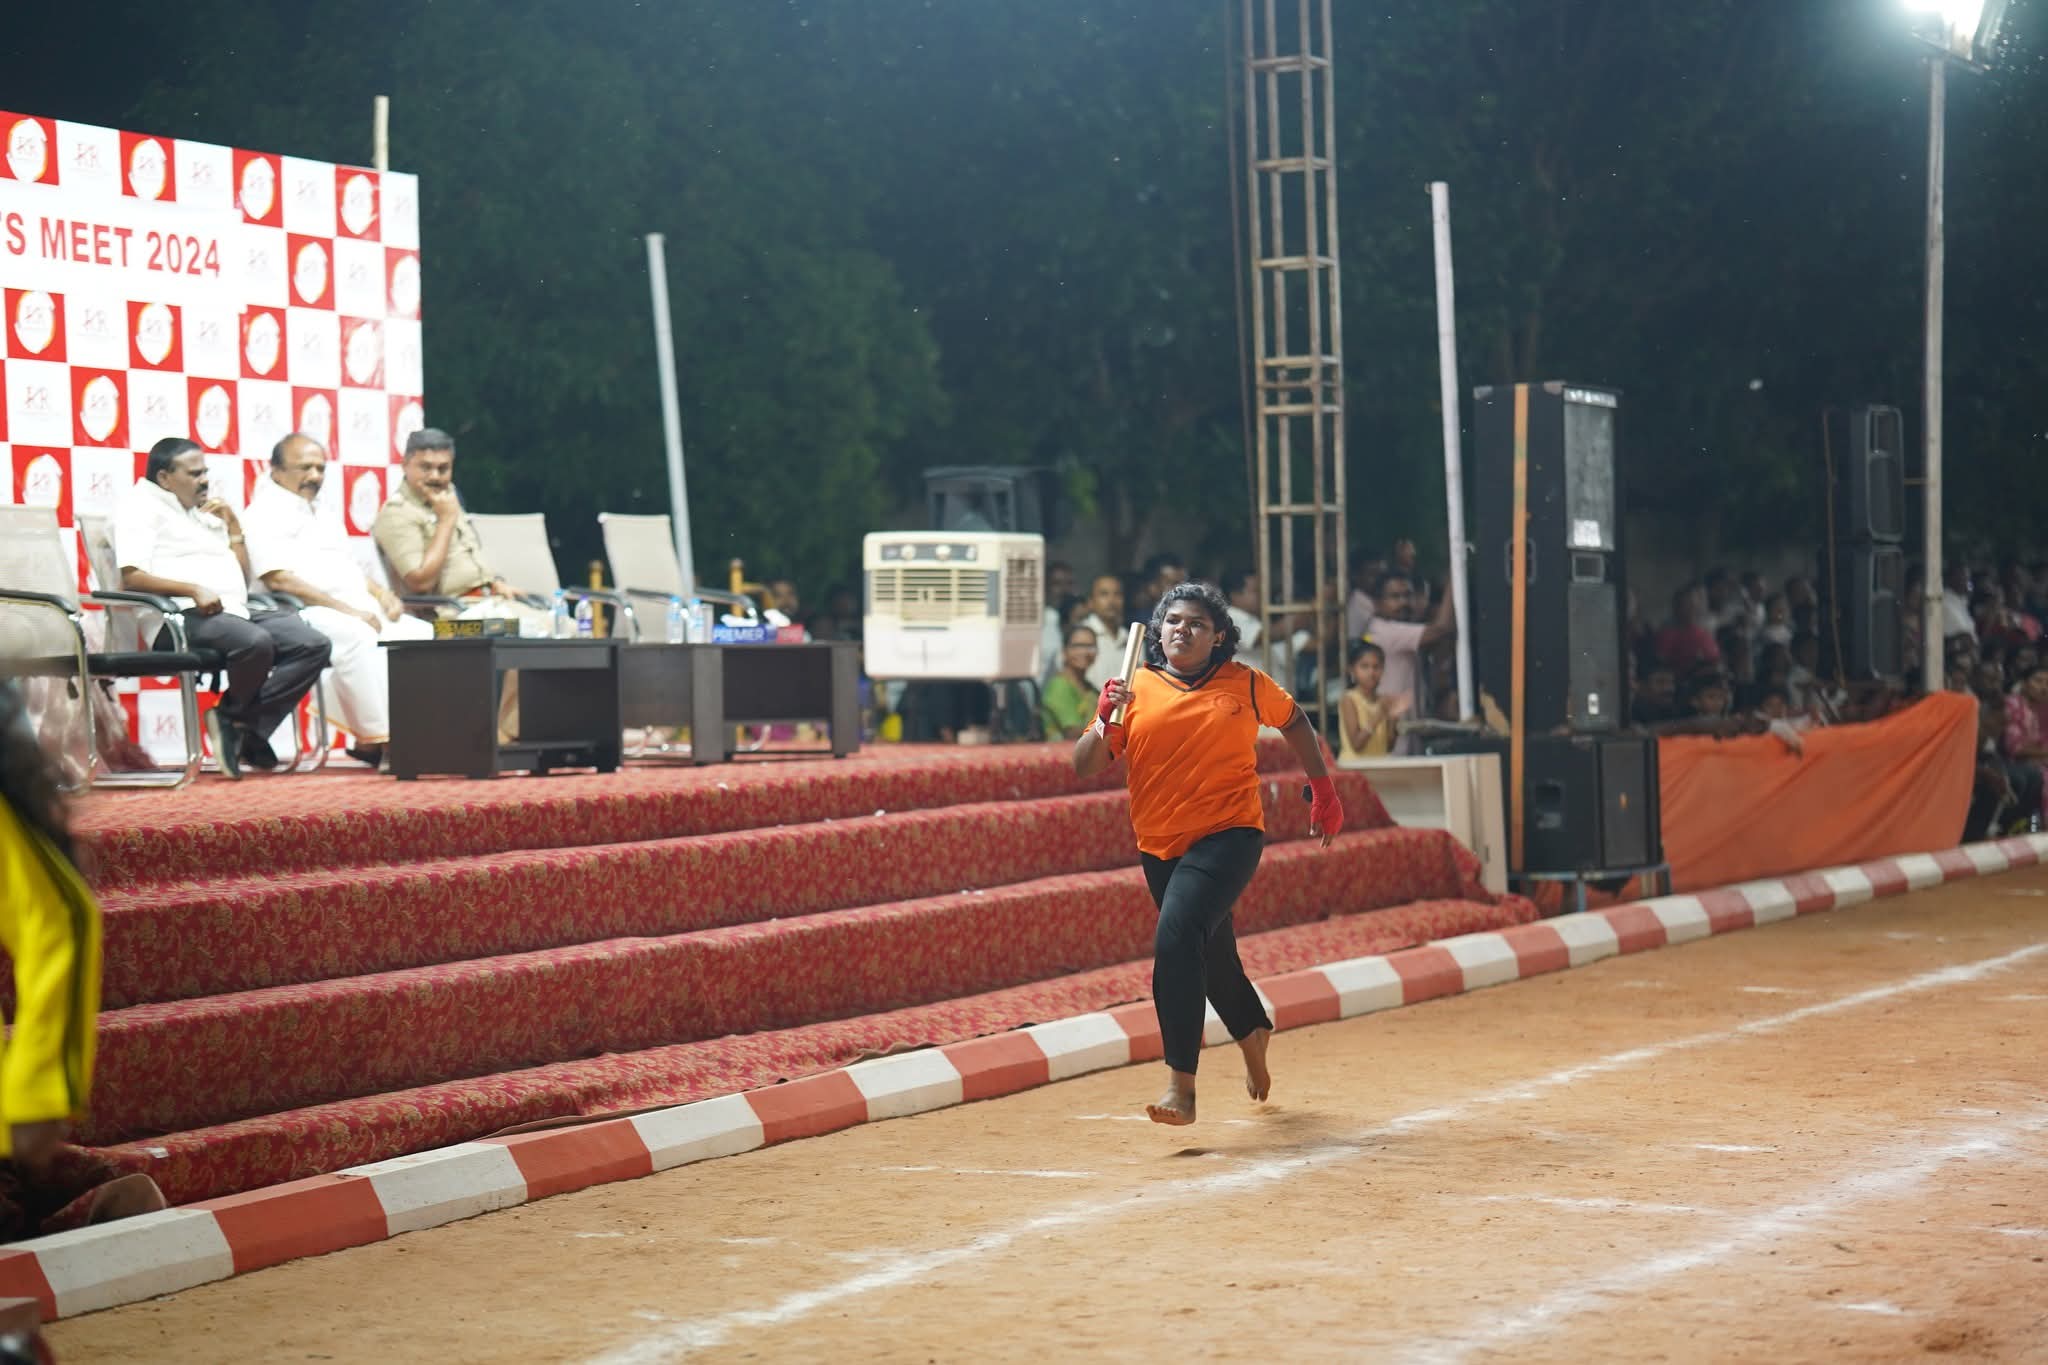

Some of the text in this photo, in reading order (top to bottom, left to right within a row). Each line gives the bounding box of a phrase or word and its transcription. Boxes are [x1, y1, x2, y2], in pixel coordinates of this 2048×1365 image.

[0, 211, 221, 277] S MEET 2024
